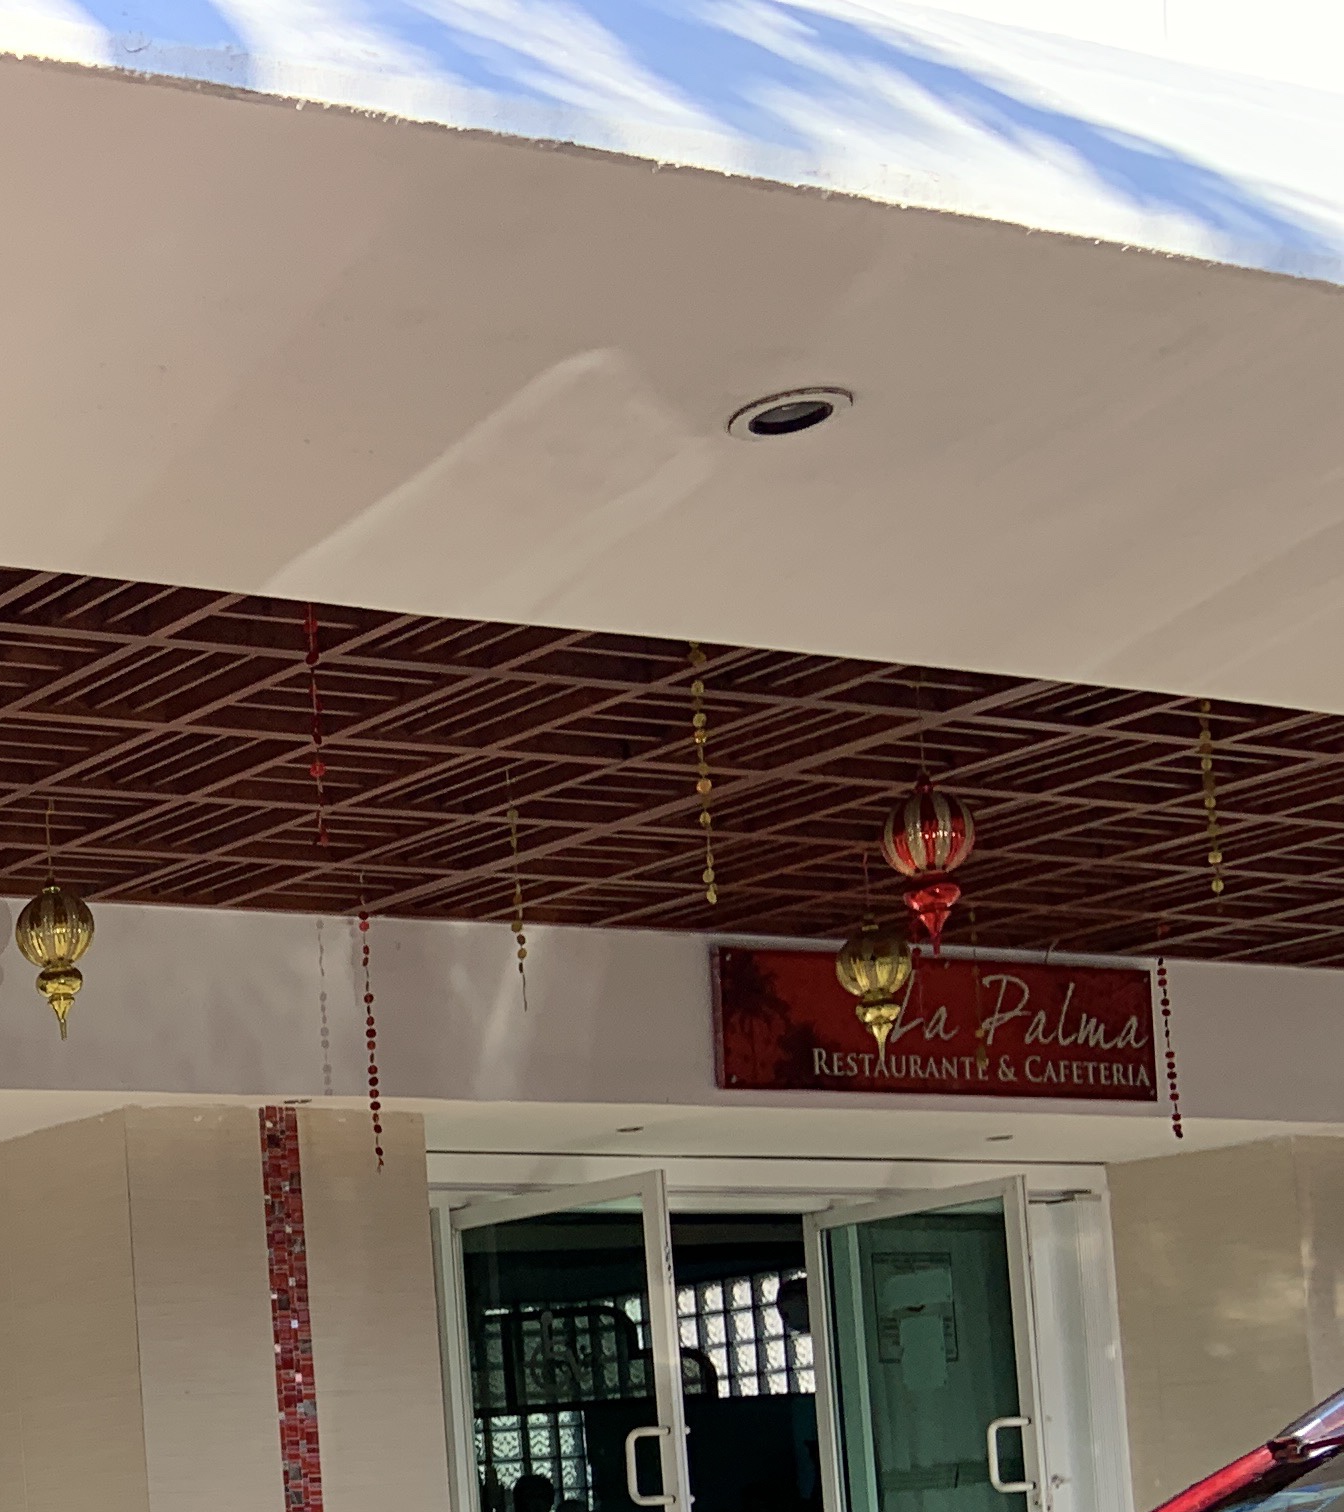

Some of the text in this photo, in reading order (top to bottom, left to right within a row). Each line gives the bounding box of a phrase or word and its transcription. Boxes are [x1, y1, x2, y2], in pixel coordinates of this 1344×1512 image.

[890, 968, 1149, 1050] La Palma
[812, 1047, 1150, 1087] RESTAURANTE & CAFETERIA
